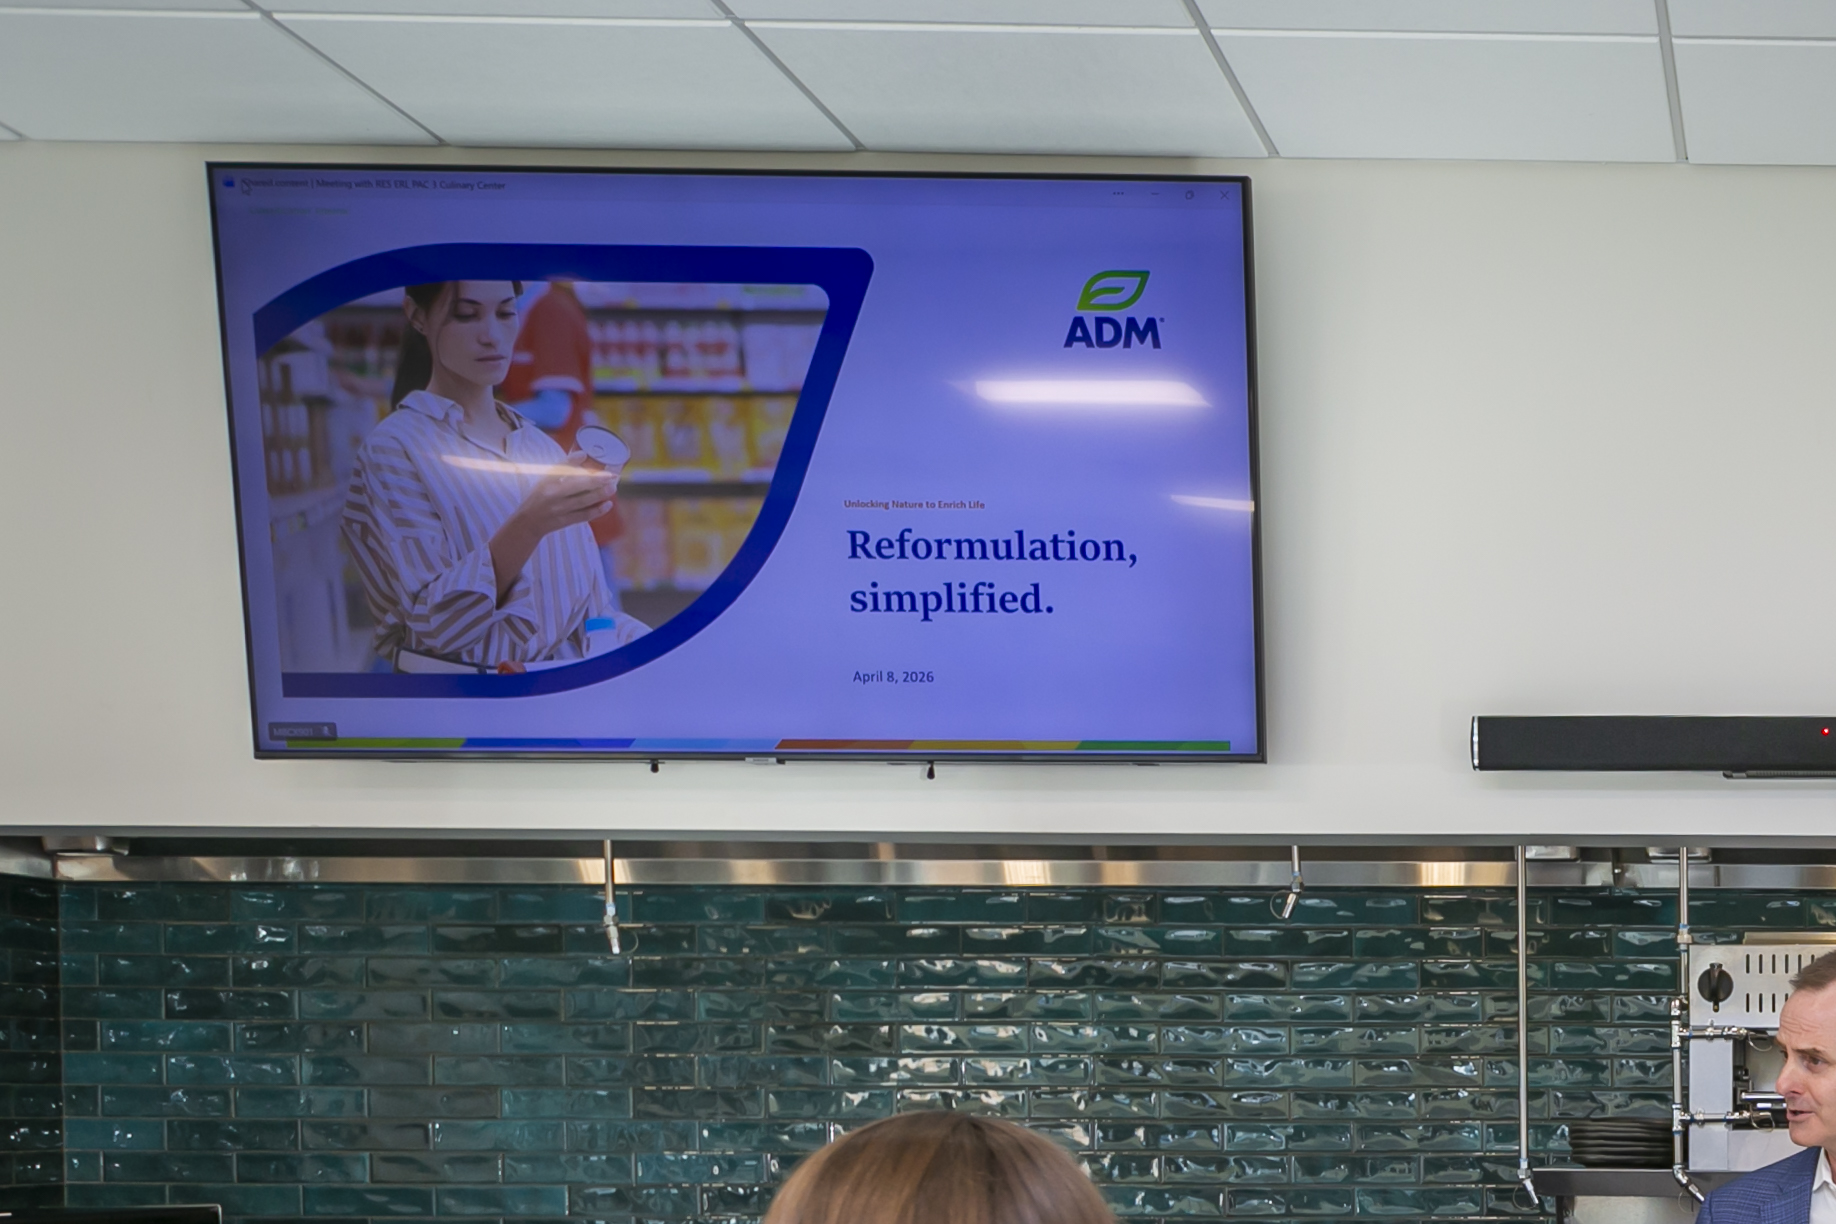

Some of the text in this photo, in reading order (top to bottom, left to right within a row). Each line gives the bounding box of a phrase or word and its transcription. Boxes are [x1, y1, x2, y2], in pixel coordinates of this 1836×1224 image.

[316, 180, 351, 189] Meeting
[439, 181, 475, 191] Culinary
[477, 182, 506, 190] Center
[1063, 316, 1162, 349] ADM
[844, 500, 889, 510] Unlocking
[892, 500, 923, 508] Nature
[938, 501, 966, 509] Enrich
[968, 501, 985, 509] Life
[847, 528, 1137, 568] Reformulation,
[849, 582, 1054, 622] simplified.
[853, 671, 935, 685] April 8, 2026
